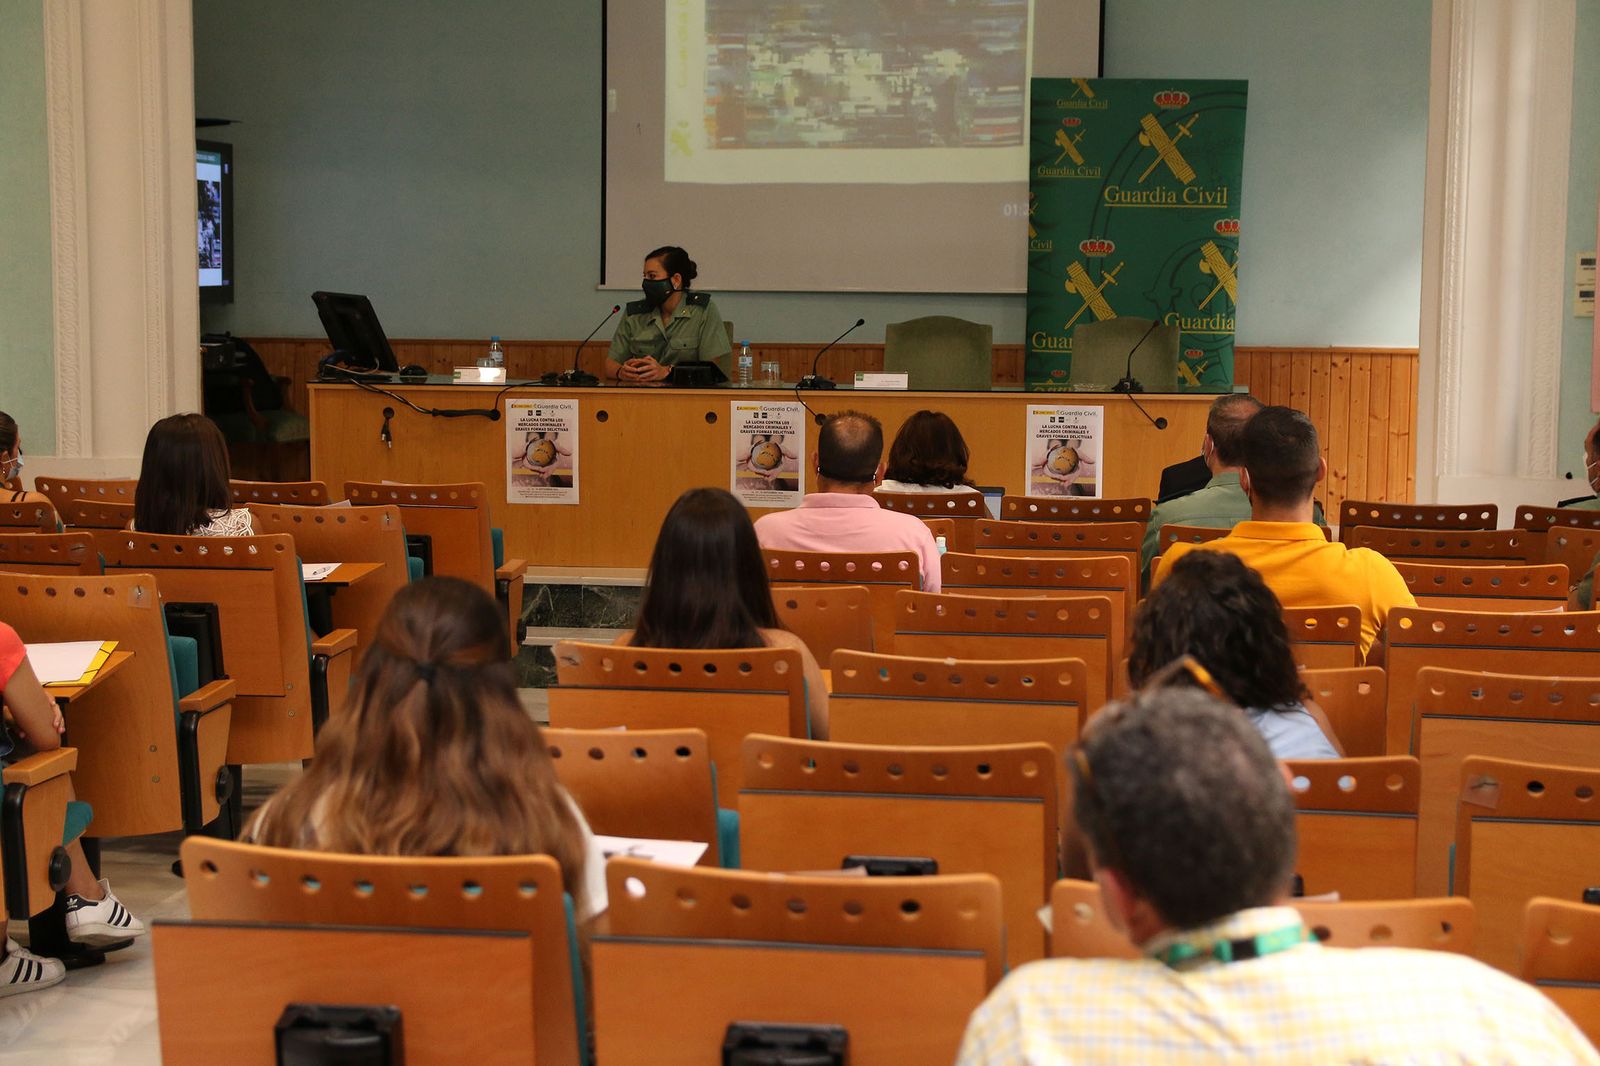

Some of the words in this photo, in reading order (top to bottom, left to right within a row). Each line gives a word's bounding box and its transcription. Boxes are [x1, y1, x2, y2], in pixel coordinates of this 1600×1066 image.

[1038, 166, 1075, 176] Guardia
[1077, 166, 1101, 176] Civil
[1104, 186, 1177, 204] Guardia
[1183, 186, 1228, 205] Civil
[1031, 240, 1052, 249] Civil
[1164, 312, 1235, 331] Guardia
[1032, 331, 1073, 349] Guar
